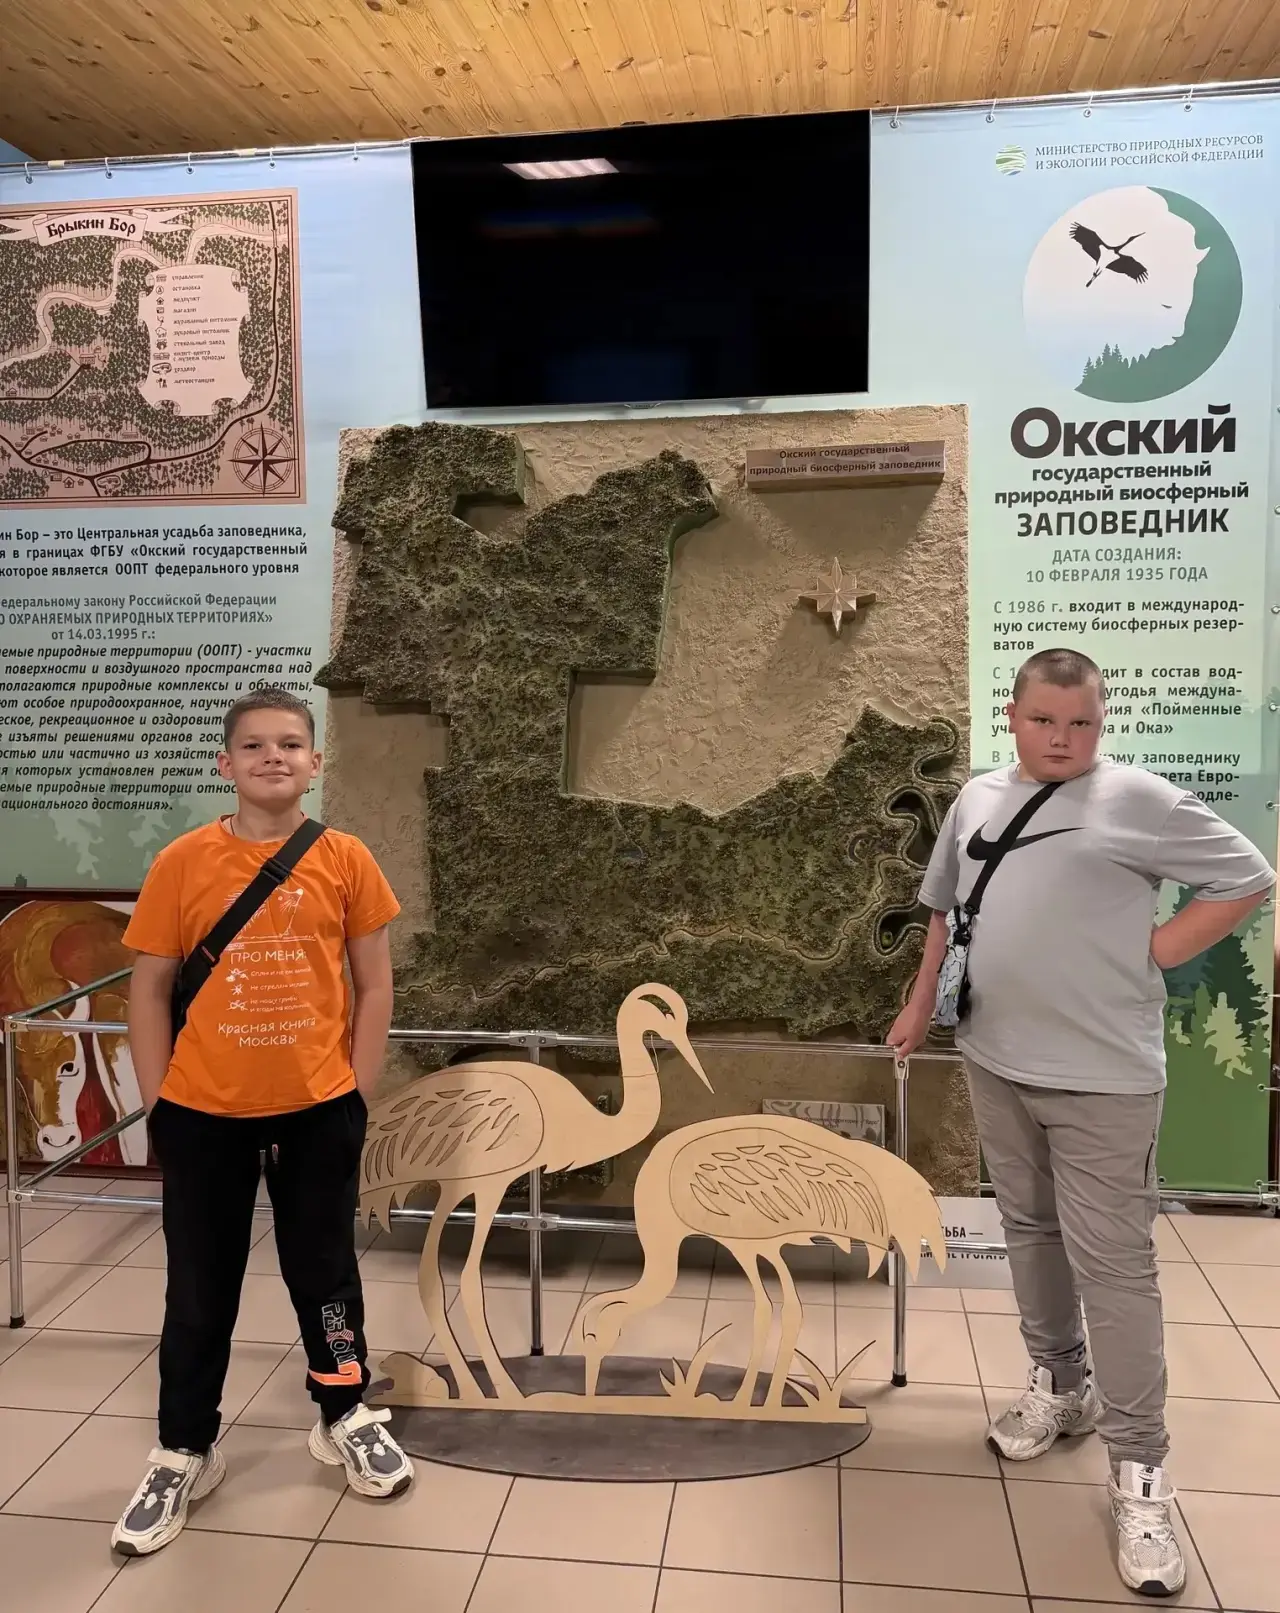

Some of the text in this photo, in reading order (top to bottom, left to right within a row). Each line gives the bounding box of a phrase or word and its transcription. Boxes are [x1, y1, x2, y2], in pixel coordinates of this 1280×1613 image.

[1035, 135, 1264, 156] МИНИСТЕРСТВО ПРИРОДНЫХ РЕСУРСОВ
[1036, 149, 1264, 170] И ЭКОЛОГИИ РОССИЙСКОЙ ФЕДЕРАЦИИ
[47, 217, 136, 238] Брыкин Бор
[1010, 403, 1236, 459] Окский
[779, 444, 910, 459] Окский государственный
[750, 459, 941, 477] природный биосферный заповедник
[1032, 460, 1212, 485] государственный
[994, 482, 1249, 508] природный биосферный
[1017, 508, 1229, 537] ЗАПОВЕДНИК
[16, 528, 39, 543] Бор
[54, 530, 73, 540] это
[77, 527, 159, 541] Центральная
[163, 524, 214, 541] усадьба
[217, 526, 307, 539] заповедника,
[13, 549, 20, 558] в
[27, 548, 84, 561] границах
[90, 544, 124, 557] ФГБУ
[131, 543, 186, 557] «Окский
[193, 542, 308, 559] государственный
[1052, 547, 1182, 565] ДАТА СОЗДАНИЯ:
[52, 566, 108, 577] является
[115, 563, 148, 575] ООПТ
[155, 563, 249, 577] федерального
[252, 564, 299, 577] уровня
[1026, 566, 1208, 583] 10 ФЕВРАЛЯ 1935 ГОДА
[84, 597, 126, 609] закону
[129, 594, 201, 607] Российской
[205, 593, 277, 608] Федерации
[993, 600, 1245, 615] С 1986 г. входит в международ-
[9, 611, 273, 626] ОХРАНЯЕМЫХ ПРИРОДНЫХ ТЕРРИТОРИЯХ»
[993, 617, 1244, 635] ную систему биосферных резер-
[51, 628, 156, 641] от 14.03.1995 г.:
[37, 645, 107, 660] природные
[110, 647, 193, 660] территории
[197, 643, 243, 660] (ООПТ)
[255, 646, 312, 659] участки
[993, 639, 1035, 651] ватов
[5, 661, 313, 677] поверхности и воздушного пространства над
[1135, 667, 1143, 678] в
[1151, 666, 1201, 679] состав
[1209, 667, 1243, 681] вод-
[81, 679, 152, 693] природные
[158, 681, 229, 692] комплексы
[235, 681, 243, 691] и
[248, 678, 313, 692] объекты,
[1105, 684, 1156, 700] угодья
[1167, 684, 1242, 699] междуна-
[23, 696, 65, 709] особое
[70, 696, 185, 711] природоохранное,
[190, 699, 237, 711] научно
[1141, 702, 1242, 716] «Пойменные
[39, 716, 135, 728] рекреационное
[139, 716, 147, 725] и
[1121, 723, 1129, 734] и
[1136, 720, 1173, 734] Ока»
[8, 732, 58, 742] изъяты
[64, 733, 135, 745] решениями
[141, 733, 193, 745] органов
[42, 750, 64, 759] или
[69, 750, 130, 759] частично
[135, 750, 149, 760] из
[1142, 752, 1241, 767] заповеднику
[15, 767, 72, 779] которых
[78, 767, 154, 779] установлен
[161, 767, 203, 779] режим
[1197, 770, 1240, 785] Евро-
[36, 781, 105, 796] природные
[110, 783, 192, 796] территории
[1, 798, 173, 811] ационального достояния».
[1193, 791, 1239, 803] одле-
[230, 950, 262, 964] ПРО
[218, 1022, 275, 1038] Красная
[941, 1226, 967, 1238] ЬБА
